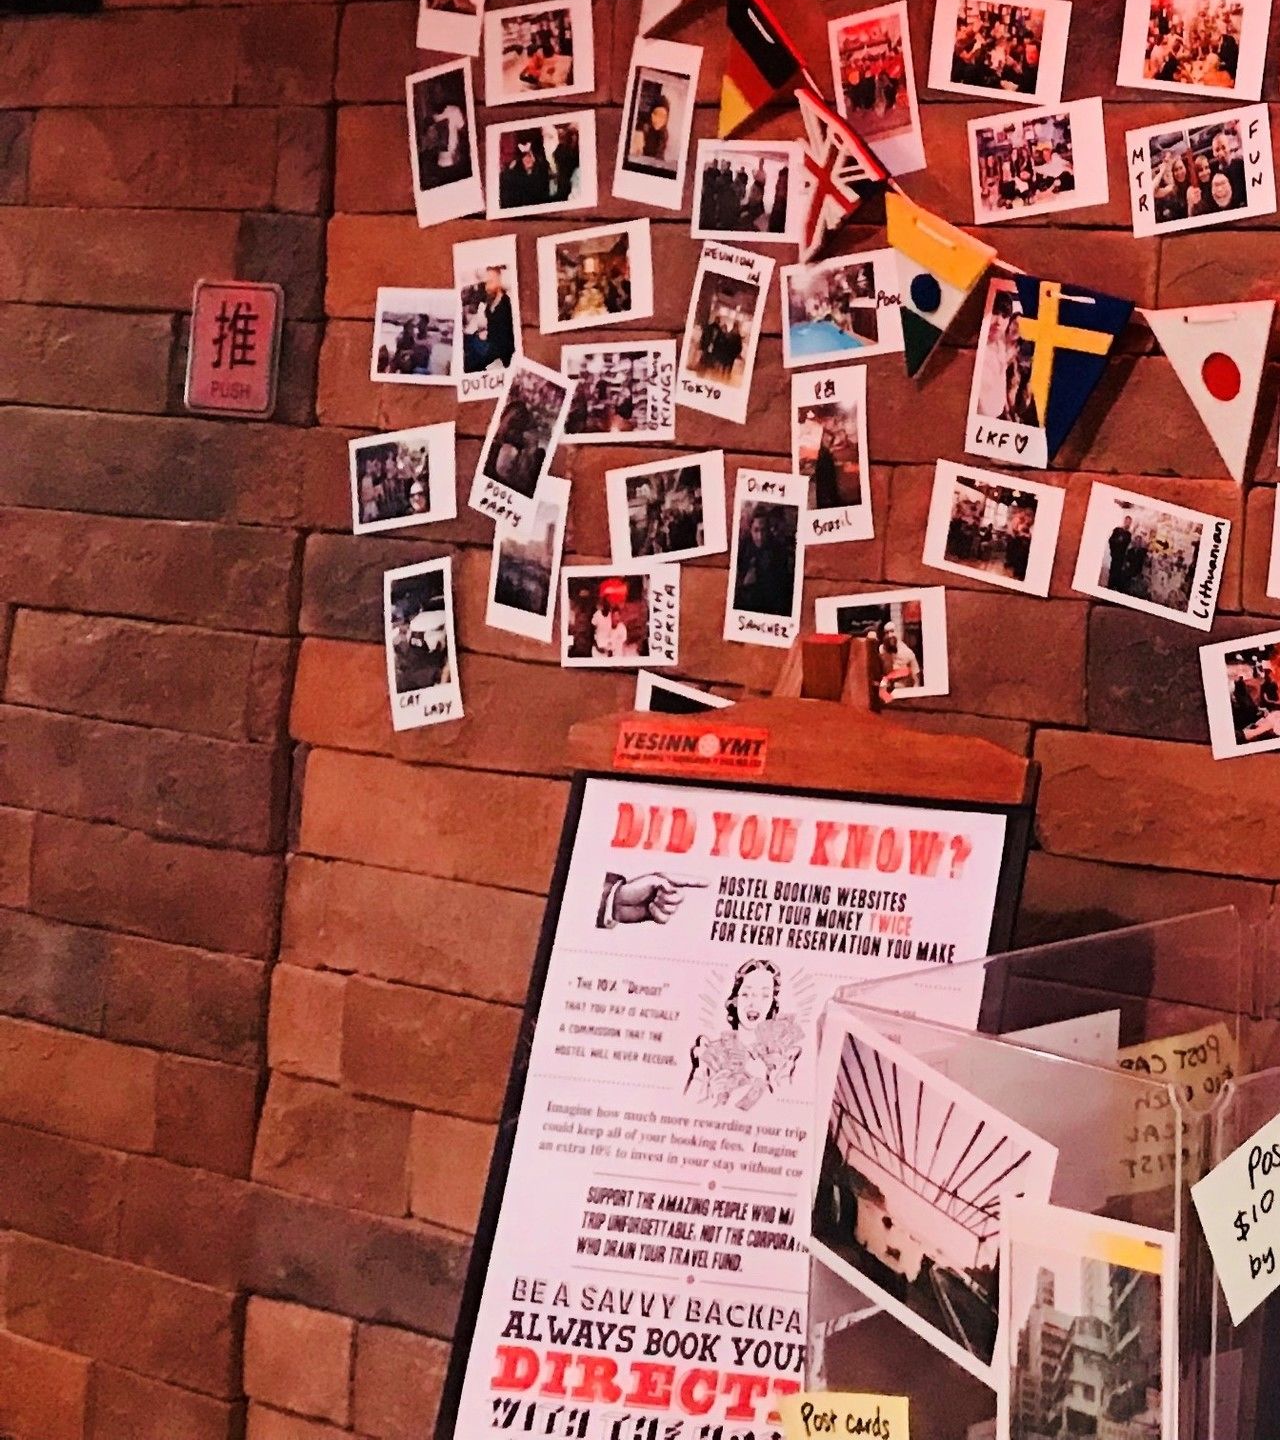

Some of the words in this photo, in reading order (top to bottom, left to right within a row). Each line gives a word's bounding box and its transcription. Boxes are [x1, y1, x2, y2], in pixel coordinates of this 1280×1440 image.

[211, 300, 259, 370] 推
[210, 380, 250, 399] PUSH
[461, 372, 505, 395] DUTCH
[681, 378, 722, 400] TOKYO
[975, 426, 1011, 448] LKF
[622, 731, 699, 753] YESINN
[719, 737, 766, 757] YMT
[609, 801, 698, 854] DID
[709, 810, 803, 864] YOU
[808, 819, 974, 881] KNOW?
[718, 875, 769, 901] HOSTEL
[773, 880, 832, 906] BOOKING
[836, 886, 908, 914] WEBSITES
[714, 898, 773, 924] COLLECT
[777, 904, 811, 928] YOUR
[814, 907, 863, 933] MONEY
[868, 912, 913, 938] TWICE
[710, 920, 738, 943] FOR
[739, 924, 784, 949] EVERY
[785, 928, 882, 958] RESERVATION
[885, 936, 913, 961] YOU
[915, 939, 956, 966] MAKE
[541, 1120, 575, 1135] could
[576, 1124, 605, 1140] keep
[639, 1130, 667, 1145] your
[669, 1133, 718, 1153] booking
[751, 1142, 800, 1159] Imagine
[546, 1100, 593, 1120] Imagine
[596, 1104, 621, 1119] how
[623, 1108, 657, 1124] much
[659, 1113, 691, 1127] more
[692, 1115, 753, 1137] rewarding
[755, 1124, 782, 1140] your
[783, 1126, 808, 1143] trip
[630, 1148, 665, 1164] invest
[681, 1154, 710, 1169] your
[712, 1155, 736, 1173] stay
[739, 1159, 784, 1177] without
[586, 1185, 635, 1208] SUPPORT
[635, 1190, 657, 1211] THE
[657, 1192, 712, 1217] AMAZING
[711, 1197, 750, 1221] PEOPLE
[750, 1203, 777, 1225] WHO
[1233, 1188, 1275, 1242] $10
[581, 1210, 607, 1231] TRIP
[700, 1223, 725, 1245] NOT
[724, 1226, 746, 1247] THE
[576, 1236, 602, 1257] WHO
[602, 1238, 637, 1260] DRAIN
[638, 1243, 667, 1264] YOUR
[668, 1246, 709, 1269] TRAVEL
[711, 1251, 743, 1273] FUND.
[1248, 1246, 1276, 1280] by
[511, 1273, 546, 1305] BE
[552, 1283, 571, 1309] A
[579, 1286, 678, 1320] SAVVY
[500, 1310, 635, 1354] ALWAYS
[642, 1327, 721, 1364] BOOK
[800, 1402, 839, 1437] Post
[844, 1405, 891, 1440] cards
